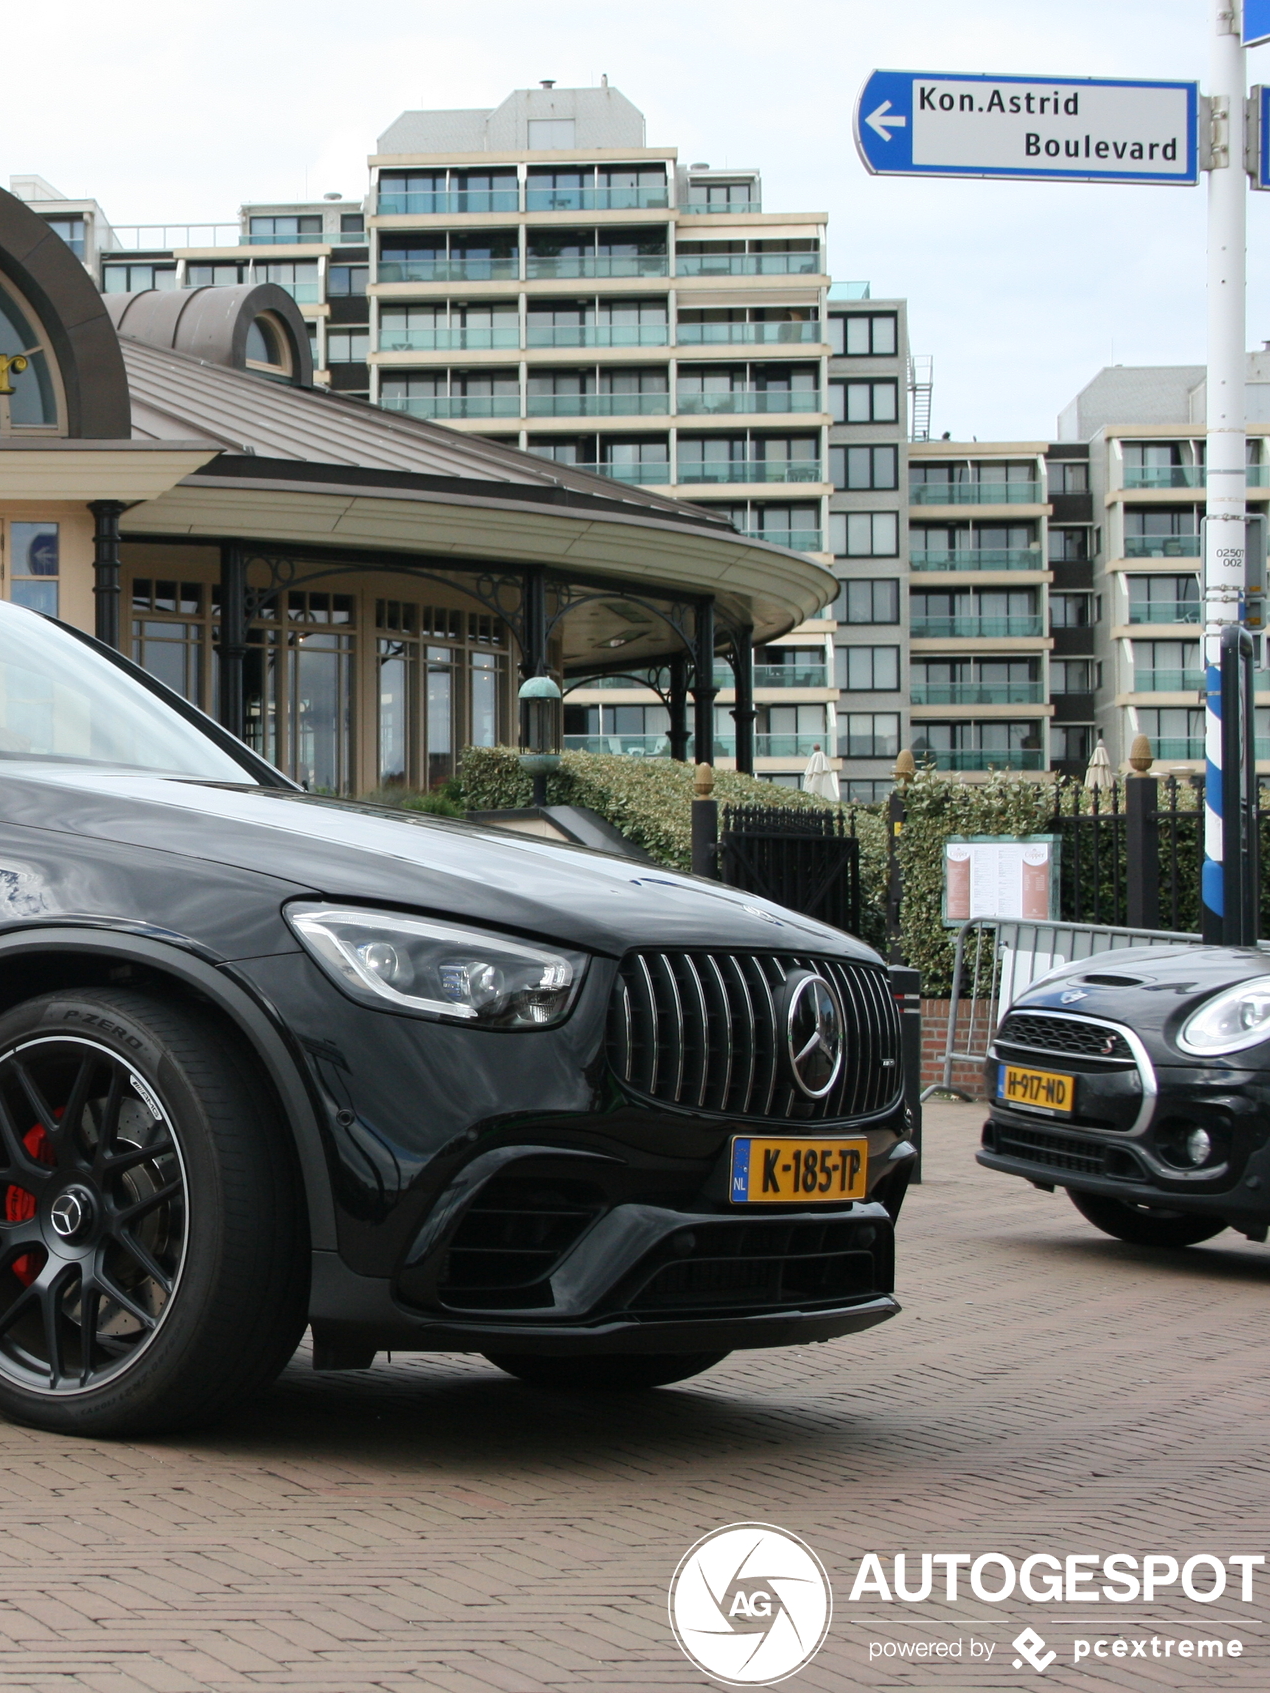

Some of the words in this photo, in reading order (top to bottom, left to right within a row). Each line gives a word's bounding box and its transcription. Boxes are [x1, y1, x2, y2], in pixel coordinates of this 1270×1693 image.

[918, 86, 1080, 116] Kon.Astrid
[1024, 132, 1178, 161] Boulevard
[1222, 558, 1243, 567] 002
[1007, 1071, 1067, 1105] H-917-ND
[733, 1177, 746, 1191] NL
[762, 1147, 861, 1193] K-185-TP
